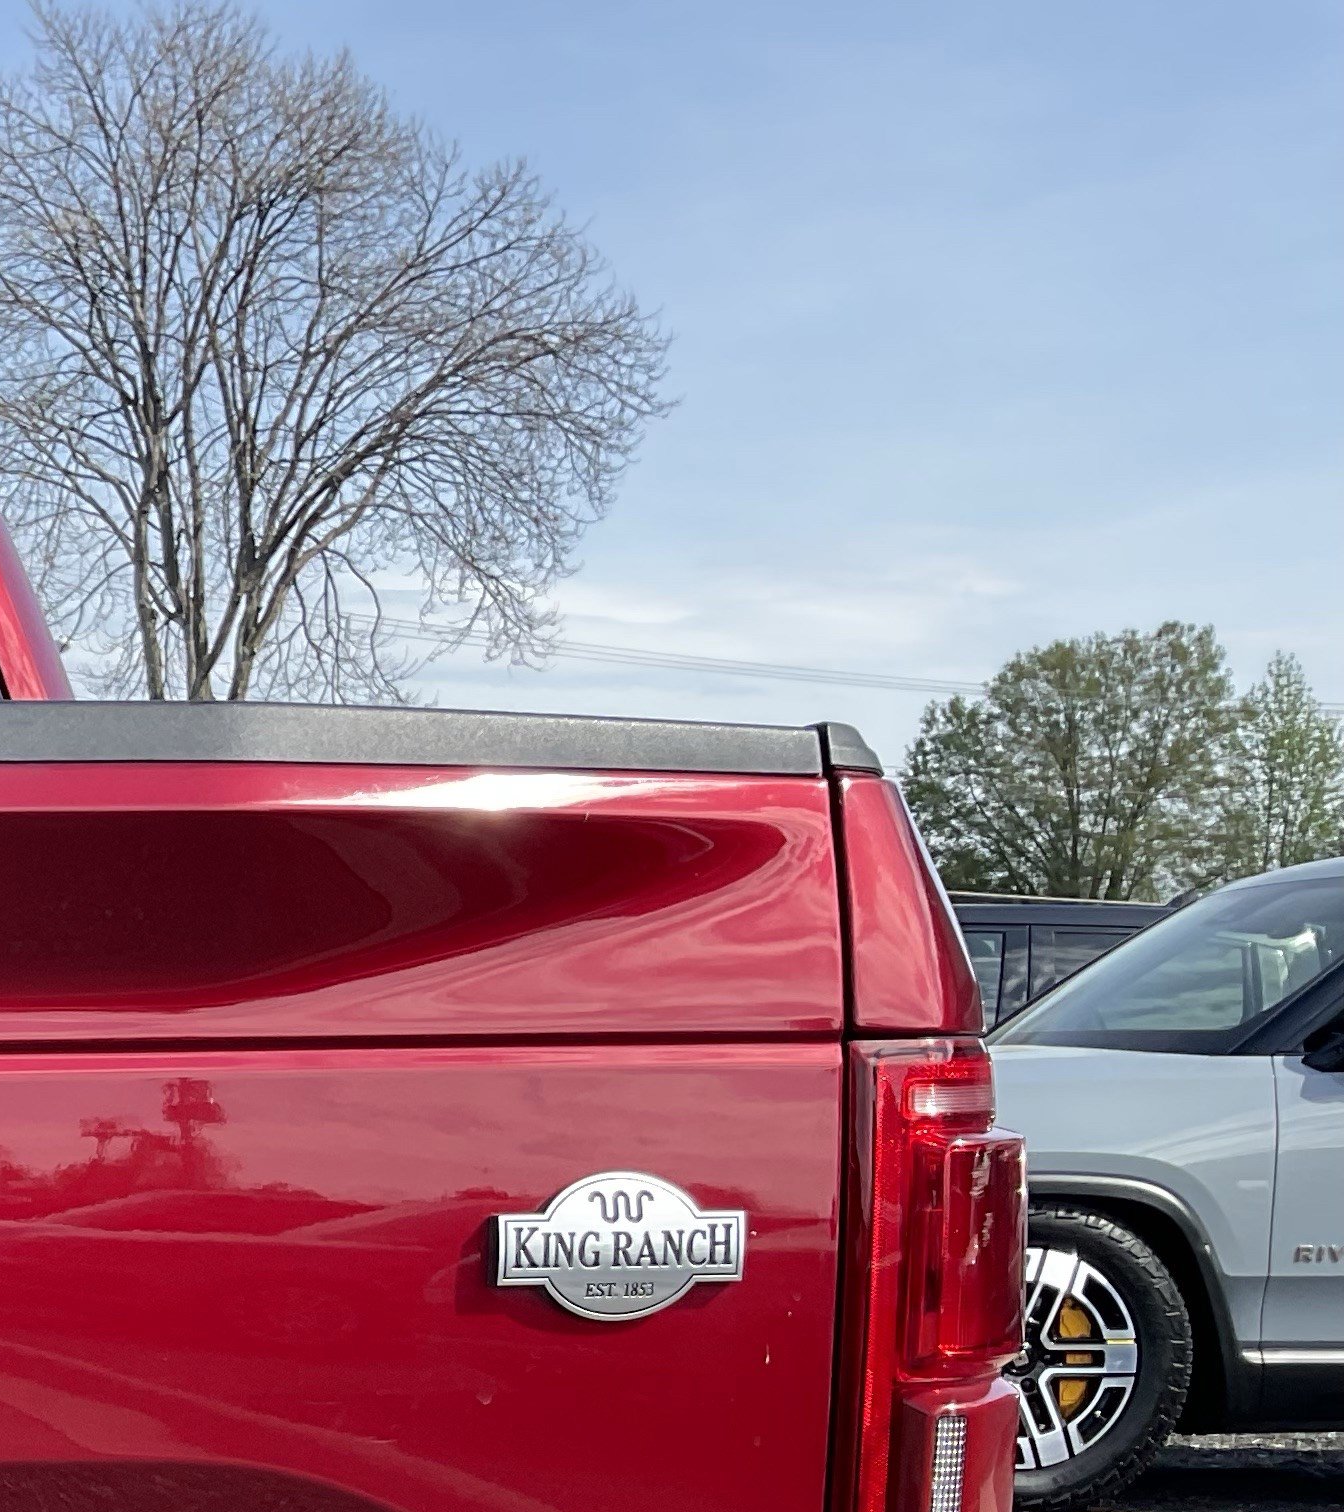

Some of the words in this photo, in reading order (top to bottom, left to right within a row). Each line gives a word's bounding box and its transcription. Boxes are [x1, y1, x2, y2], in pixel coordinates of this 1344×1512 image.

[512, 1226, 601, 1269] KING
[611, 1223, 734, 1268] RANCH
[584, 1283, 619, 1299] EST.
[623, 1282, 655, 1298] 1853
